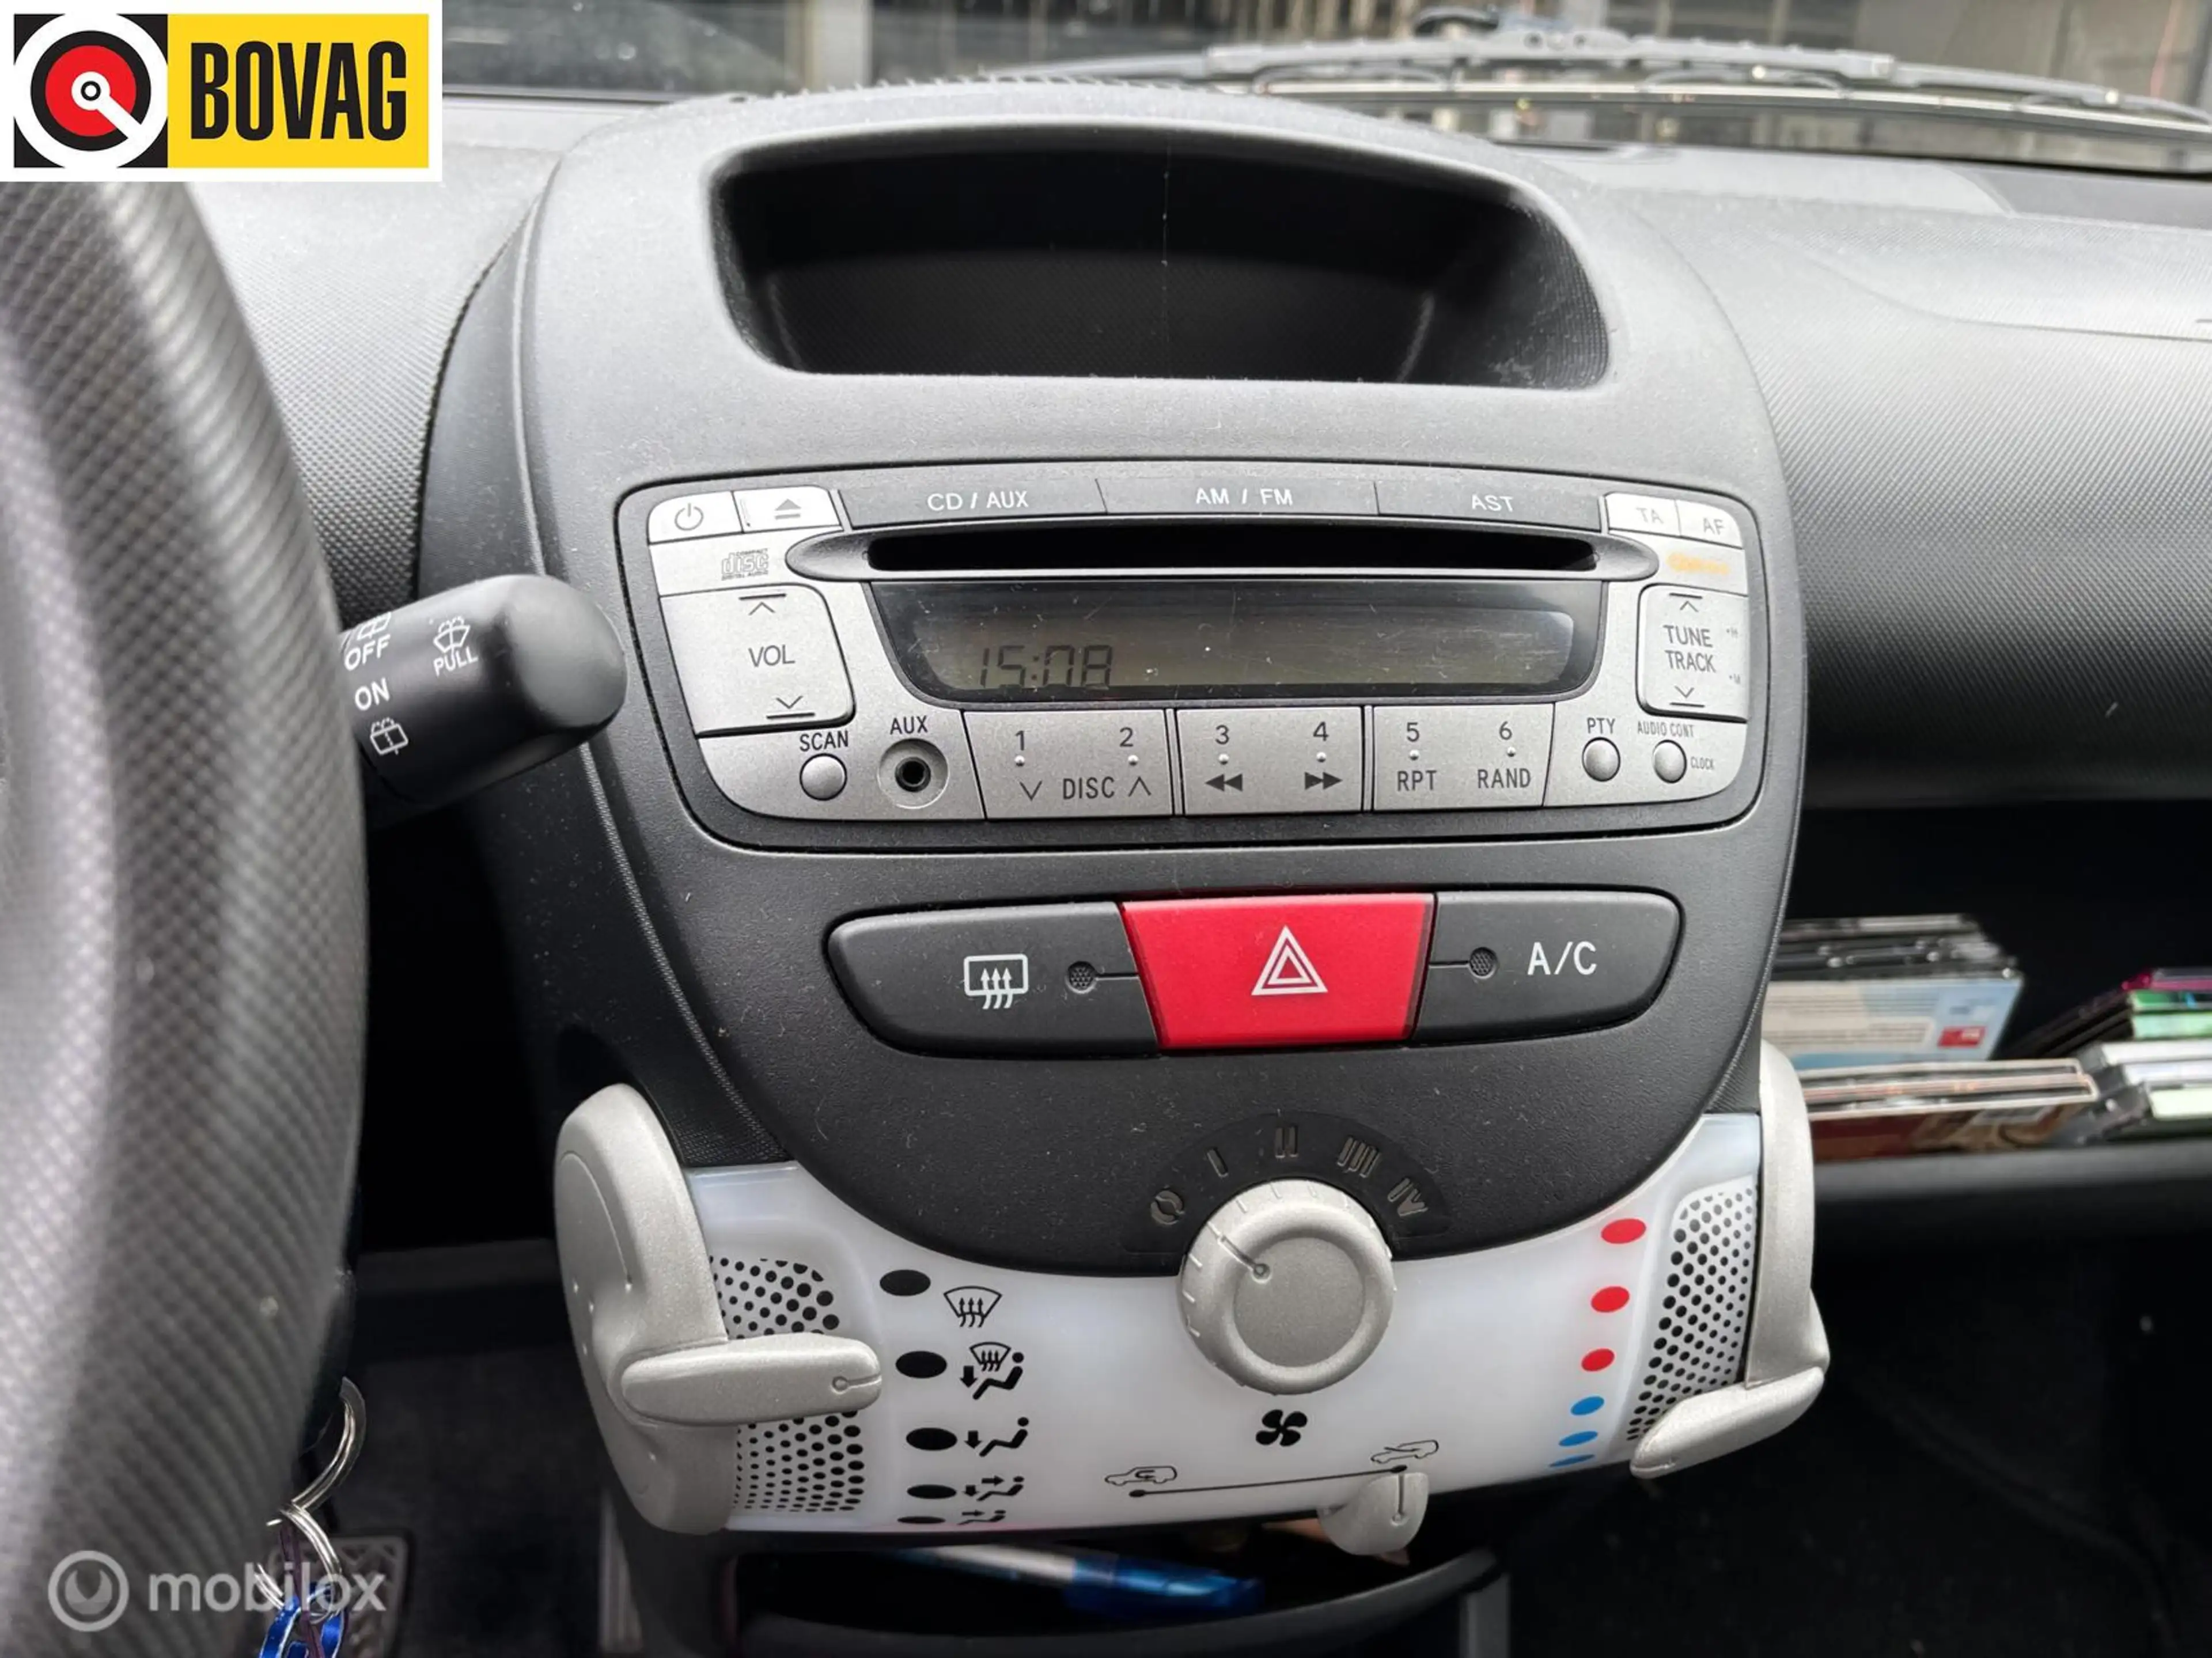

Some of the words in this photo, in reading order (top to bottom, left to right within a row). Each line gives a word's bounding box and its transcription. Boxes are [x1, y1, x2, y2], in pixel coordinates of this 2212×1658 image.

[927, 493, 963, 511] CD
[986, 491, 1029, 508] AUX
[1196, 487, 1230, 504] AM
[1260, 488, 1293, 505] FM
[1471, 495, 1514, 512] AST
[1636, 507, 1664, 524] TA
[1703, 517, 1725, 535] AF
[1663, 624, 1714, 648] TUNE
[344, 633, 391, 671] OFF
[433, 646, 479, 677] PULL
[748, 644, 796, 667] VOL
[1665, 650, 1716, 673] TRACK
[980, 644, 1112, 688] 15:08
[354, 677, 390, 711] ON
[889, 715, 929, 734] AUX
[1215, 724, 1230, 745] 3
[1312, 721, 1330, 742] 4
[1406, 722, 1421, 742] 5
[1499, 720, 1513, 741] 6
[1587, 717, 1615, 734] PTY
[1638, 721, 1668, 737] AUDIO
[1670, 723, 1695, 738] CONT
[800, 730, 849, 752] SCAN
[1015, 730, 1026, 750] 1
[1119, 727, 1134, 747] 2
[1690, 756, 1715, 770] CLOCK
[1062, 777, 1115, 799] DISC
[1397, 770, 1437, 791] RPT
[1478, 768, 1532, 789] RAND
[1527, 941, 1597, 976] A/C
